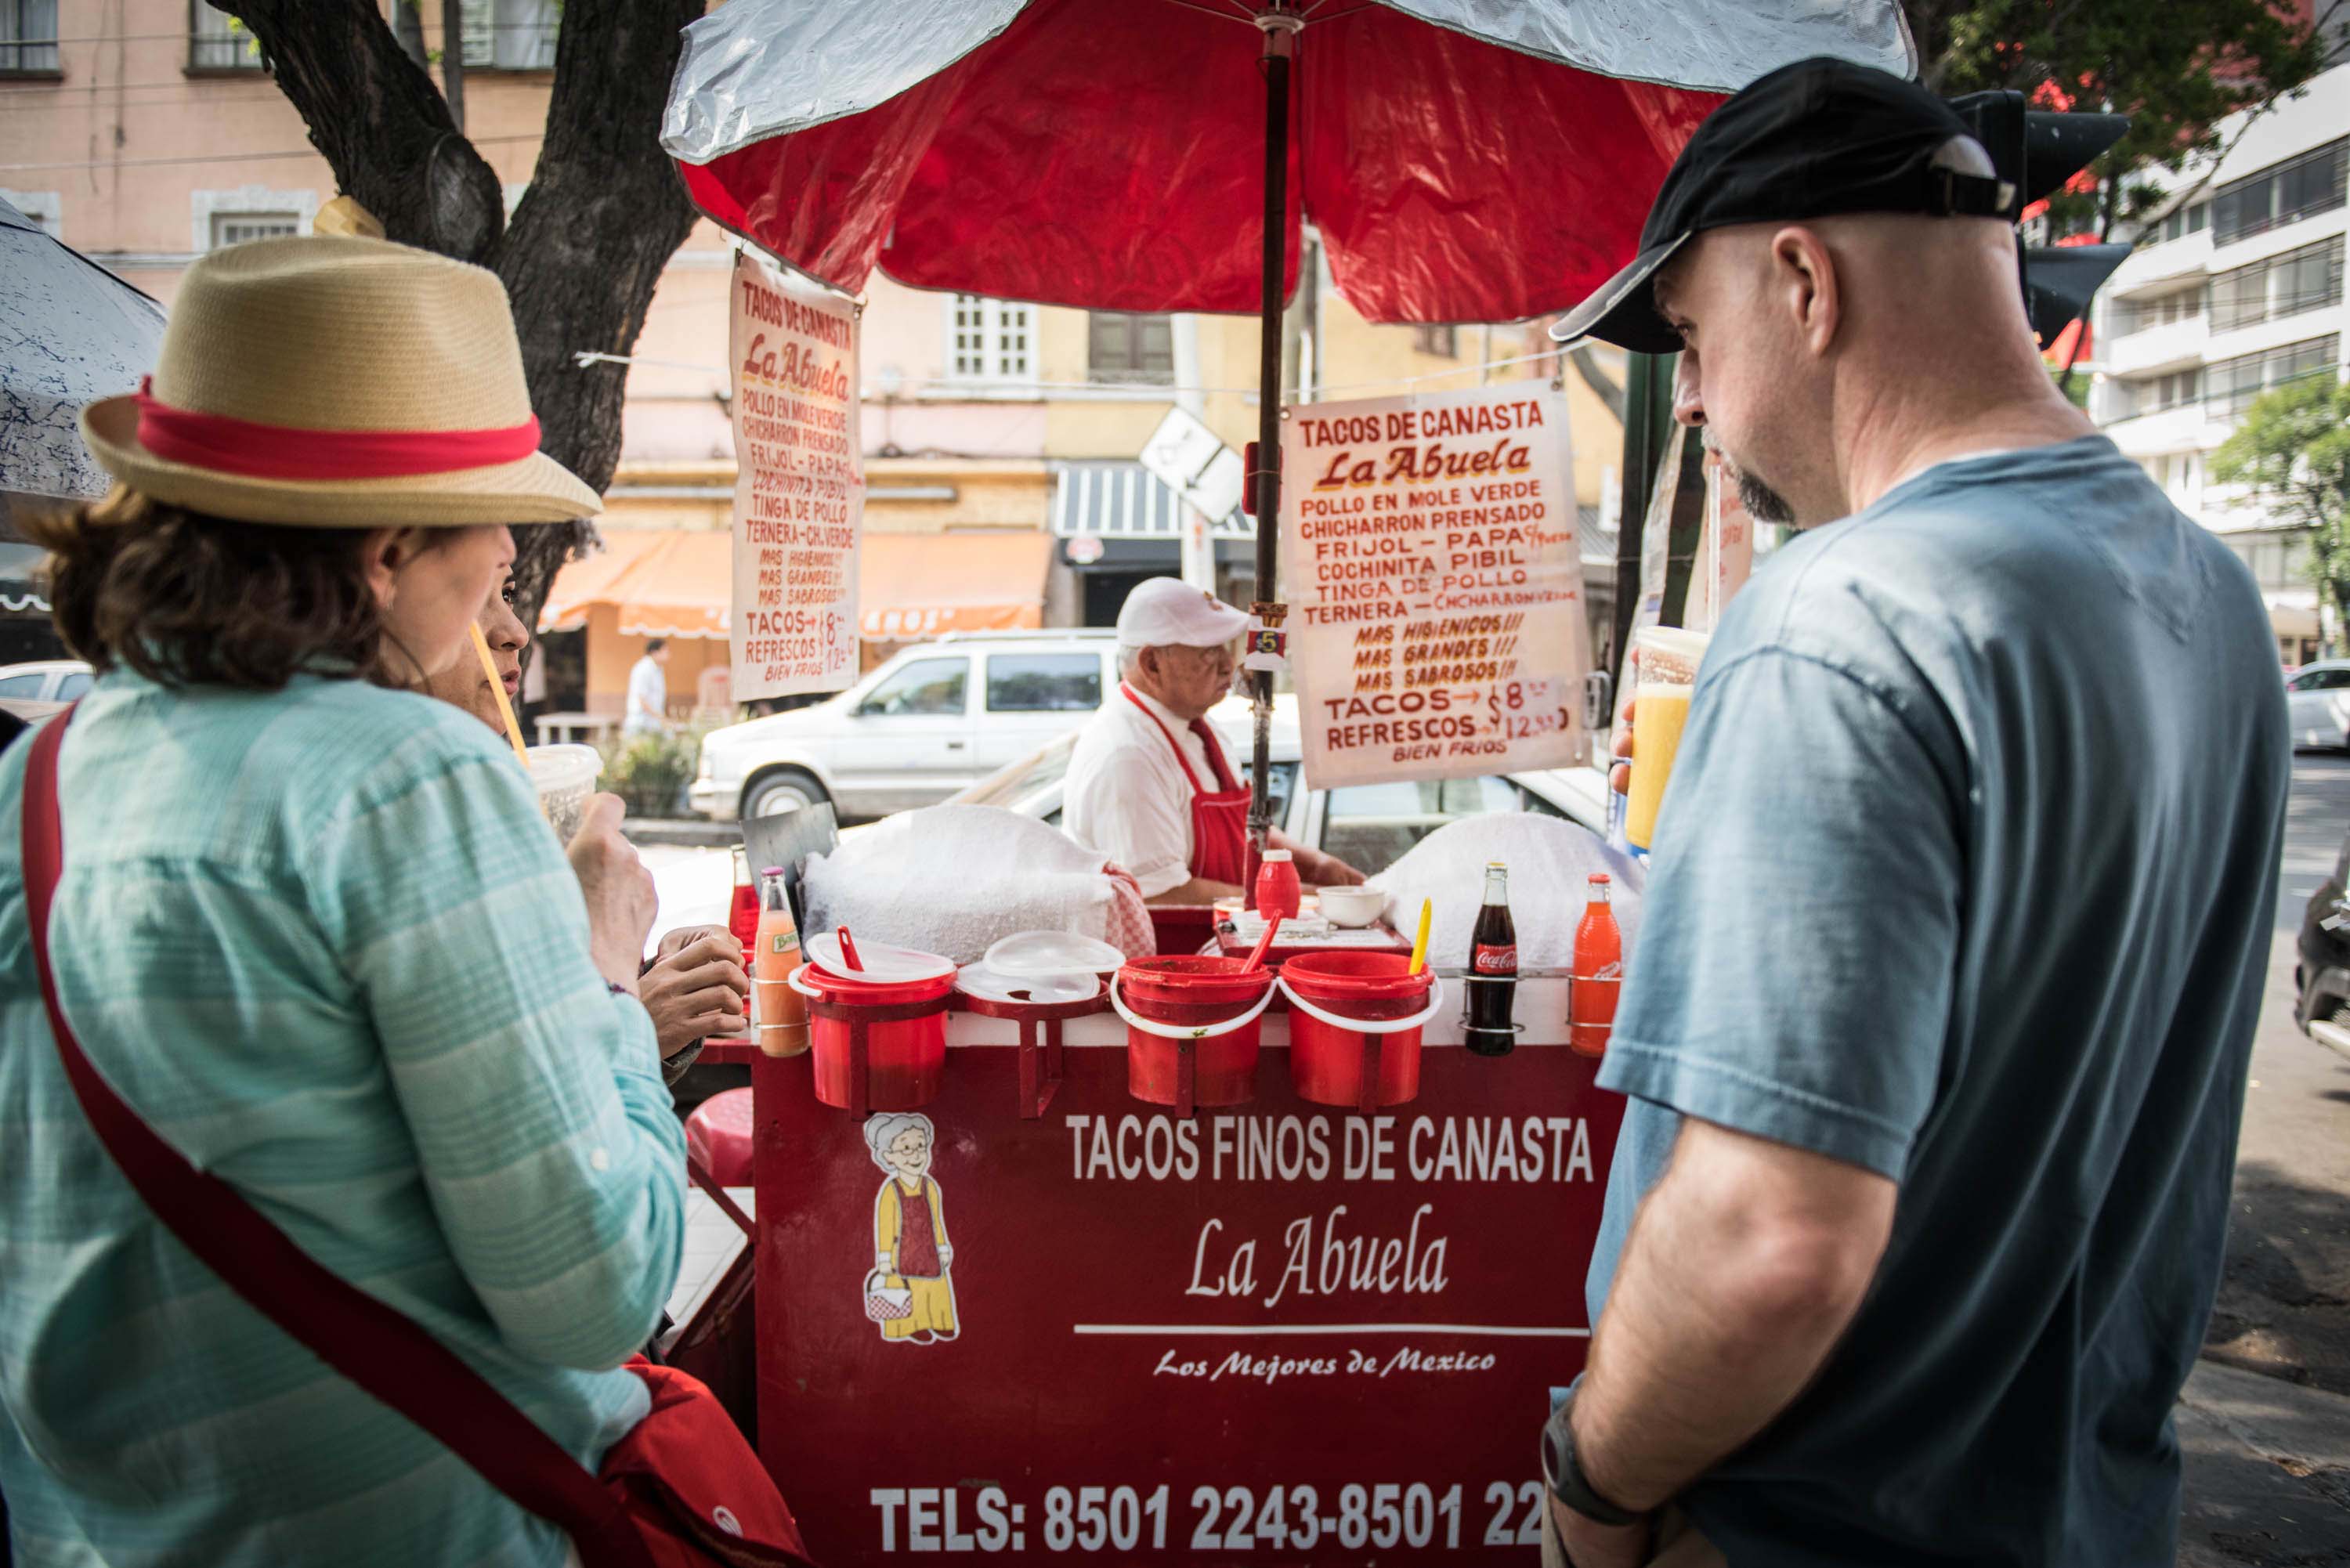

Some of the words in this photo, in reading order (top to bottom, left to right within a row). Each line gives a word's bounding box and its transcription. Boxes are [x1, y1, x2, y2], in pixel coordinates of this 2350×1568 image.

[743, 280, 783, 327] TACOS
[784, 298, 800, 332] DE
[801, 305, 851, 351] CANASTA
[742, 333, 777, 386] La
[779, 341, 849, 402] Abuela
[743, 388, 775, 417] POLLO
[777, 396, 789, 419] EN
[791, 400, 815, 425] MOLE
[815, 408, 846, 432] VERDE
[1299, 414, 1381, 448] TACOS
[1386, 412, 1417, 443] DE
[1422, 400, 1544, 438] CANASTA
[743, 416, 800, 446] CHICHARRON
[803, 428, 848, 455] PRENSADO
[750, 443, 797, 471] FRIJOL
[1312, 451, 1377, 492] La
[1382, 438, 1532, 486] Abuela
[753, 469, 813, 497] COCHINITA
[816, 479, 846, 500] PIBIL
[1300, 497, 1365, 517] POLLO
[1372, 493, 1397, 511] EN
[1408, 488, 1461, 509] MOLE
[1470, 479, 1542, 502] VERDE
[753, 493, 792, 519] TINGA
[796, 499, 809, 520] DE
[814, 501, 847, 523] POLLO
[1300, 514, 1426, 540] CHICHARRON
[1431, 502, 1546, 529] PRENSADO
[760, 548, 783, 565] MAS
[1316, 537, 1412, 560] FRIJOL
[1446, 527, 1524, 550] PAPA
[759, 569, 782, 585] MAS
[1318, 555, 1436, 582] COCHINITA
[1452, 548, 1524, 570] PIBIL
[758, 589, 782, 605] MAS
[1316, 580, 1393, 602] TINGA
[1402, 578, 1430, 594] DE
[1442, 569, 1527, 591] POLLO
[747, 610, 804, 635] TACOS
[1303, 601, 1408, 624] TERNERA
[746, 638, 815, 664] REFRESCOS
[1354, 624, 1394, 648] MAS
[765, 665, 791, 681] BIEN
[794, 662, 823, 676] FRIOS
[1353, 648, 1393, 670] MAS
[1354, 670, 1393, 693] MAS
[1324, 689, 1451, 721] TACOS
[1326, 715, 1477, 751] REFRESCOS
[1393, 744, 1441, 762] BIEN
[1448, 740, 1507, 757] FRIOS
[1066, 1115, 1199, 1180] TACOS
[1213, 1115, 1330, 1180] FINOS
[1343, 1115, 1397, 1180] DE
[1408, 1115, 1593, 1183] CANASTA
[1185, 1218, 1257, 1297] La
[1264, 1203, 1448, 1309] Abuela
[1154, 1349, 1206, 1377] Los
[1209, 1346, 1336, 1385] Mejores
[1347, 1348, 1377, 1375] de
[1379, 1347, 1496, 1378] Mexico
[870, 1487, 1025, 1552] TELS:
[1043, 1484, 1170, 1551] 8501
[1190, 1483, 1464, 1551] 2243-8501
